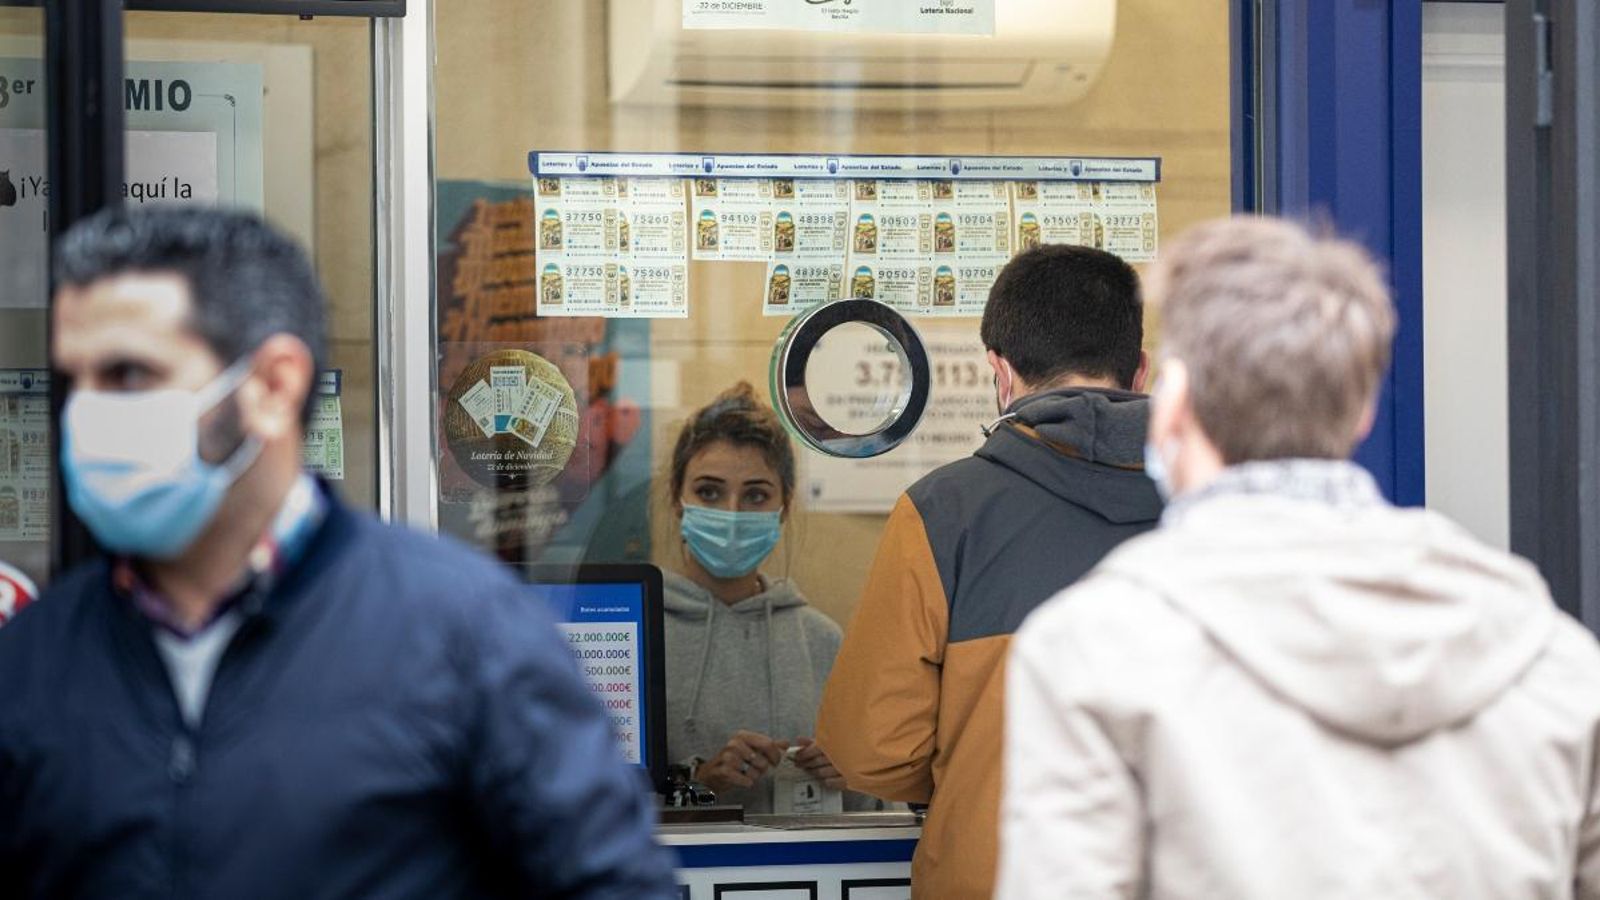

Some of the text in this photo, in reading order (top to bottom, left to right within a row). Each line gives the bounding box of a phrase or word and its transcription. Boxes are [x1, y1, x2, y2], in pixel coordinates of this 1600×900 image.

[124, 79, 192, 112] MIO
[174, 176, 192, 199] la
[566, 212, 602, 222] 37750
[721, 214, 757, 224] 94109
[799, 215, 834, 224] 48398
[566, 267, 603, 276] 37750
[633, 269, 670, 277] 75260
[878, 270, 916, 279] 90502
[504, 450, 515, 460] de
[516, 449, 554, 460] Navidad
[568, 649, 631, 660] 0.000.000€
